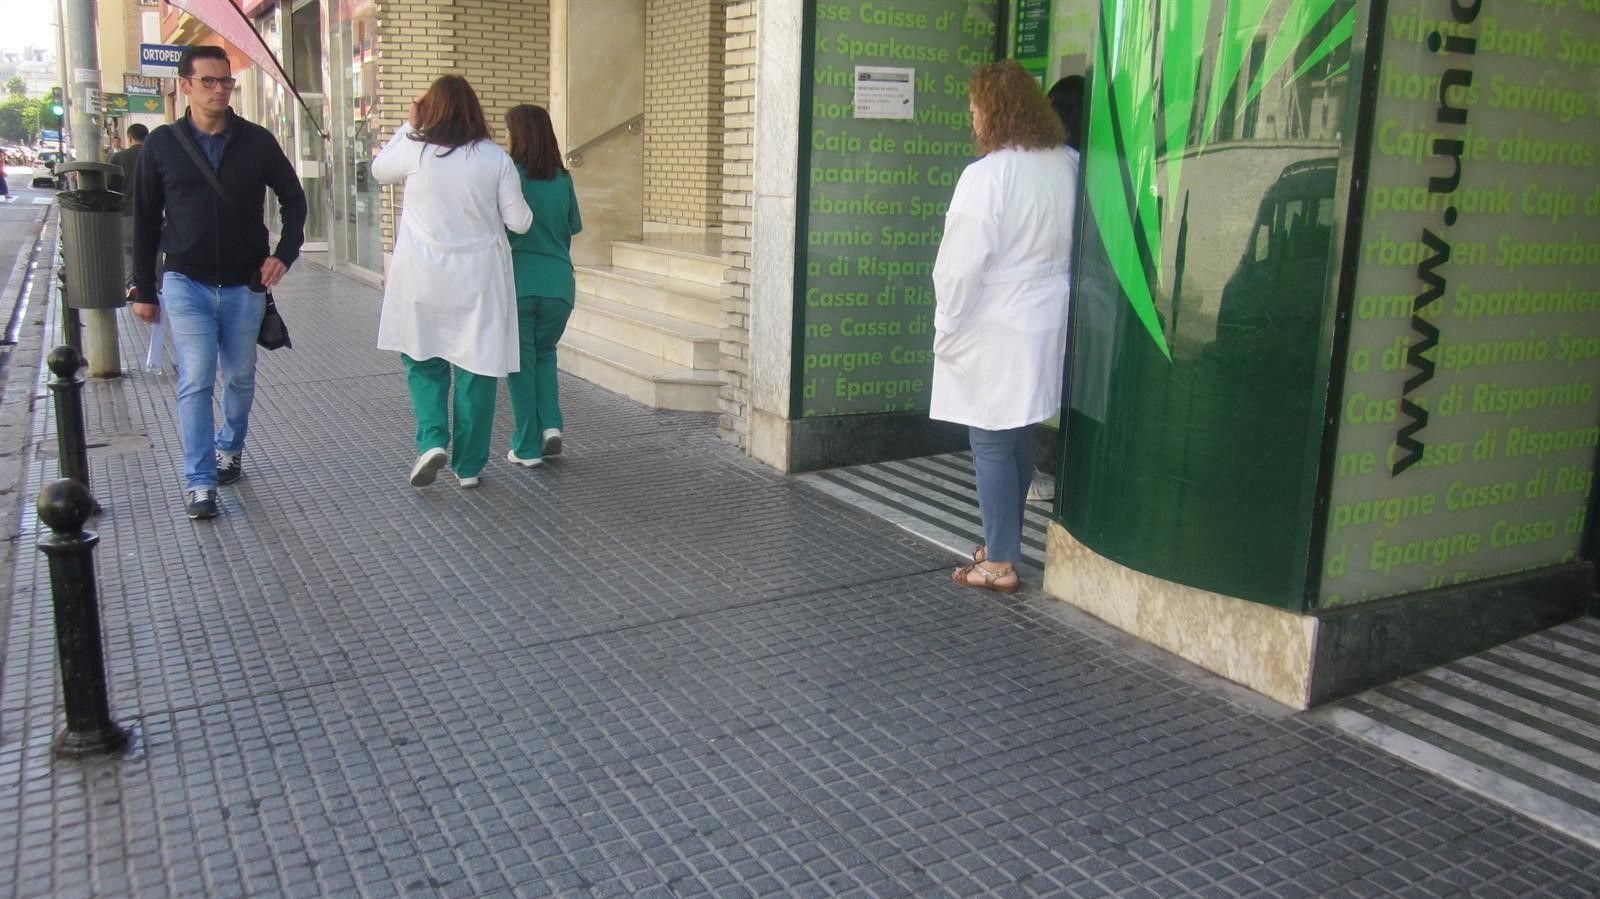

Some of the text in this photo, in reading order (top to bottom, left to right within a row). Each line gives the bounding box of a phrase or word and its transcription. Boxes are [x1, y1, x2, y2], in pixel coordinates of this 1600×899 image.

[859, 2, 928, 29] Caisse
[836, 32, 949, 63] Sparkasse
[1478, 16, 1549, 57] Bank
[944, 76, 970, 98] Sp
[1488, 73, 1588, 123] Savings
[812, 129, 974, 157] Caja de ahorro
[1499, 128, 1594, 166] ahorros
[811, 163, 919, 188] paarbank
[1522, 182, 1577, 224] Caja
[809, 225, 874, 246] armio
[807, 263, 821, 277] a
[828, 256, 849, 277] di
[806, 286, 932, 307] Cassa di Ris
[806, 315, 927, 337] ne Cassa di
[804, 351, 883, 374] pargne
[1352, 346, 1371, 373] a
[835, 371, 924, 400] Épargne
[1438, 384, 1464, 417] di
[1472, 376, 1594, 419] Risparmio
[1339, 450, 1377, 477] ne
[1471, 430, 1497, 461] di
[1331, 492, 1437, 537] pargne
[1446, 480, 1519, 512] Cassa
[1525, 464, 1550, 494] di
[1370, 529, 1481, 577] Épargne
[1490, 518, 1557, 549] Cassa
